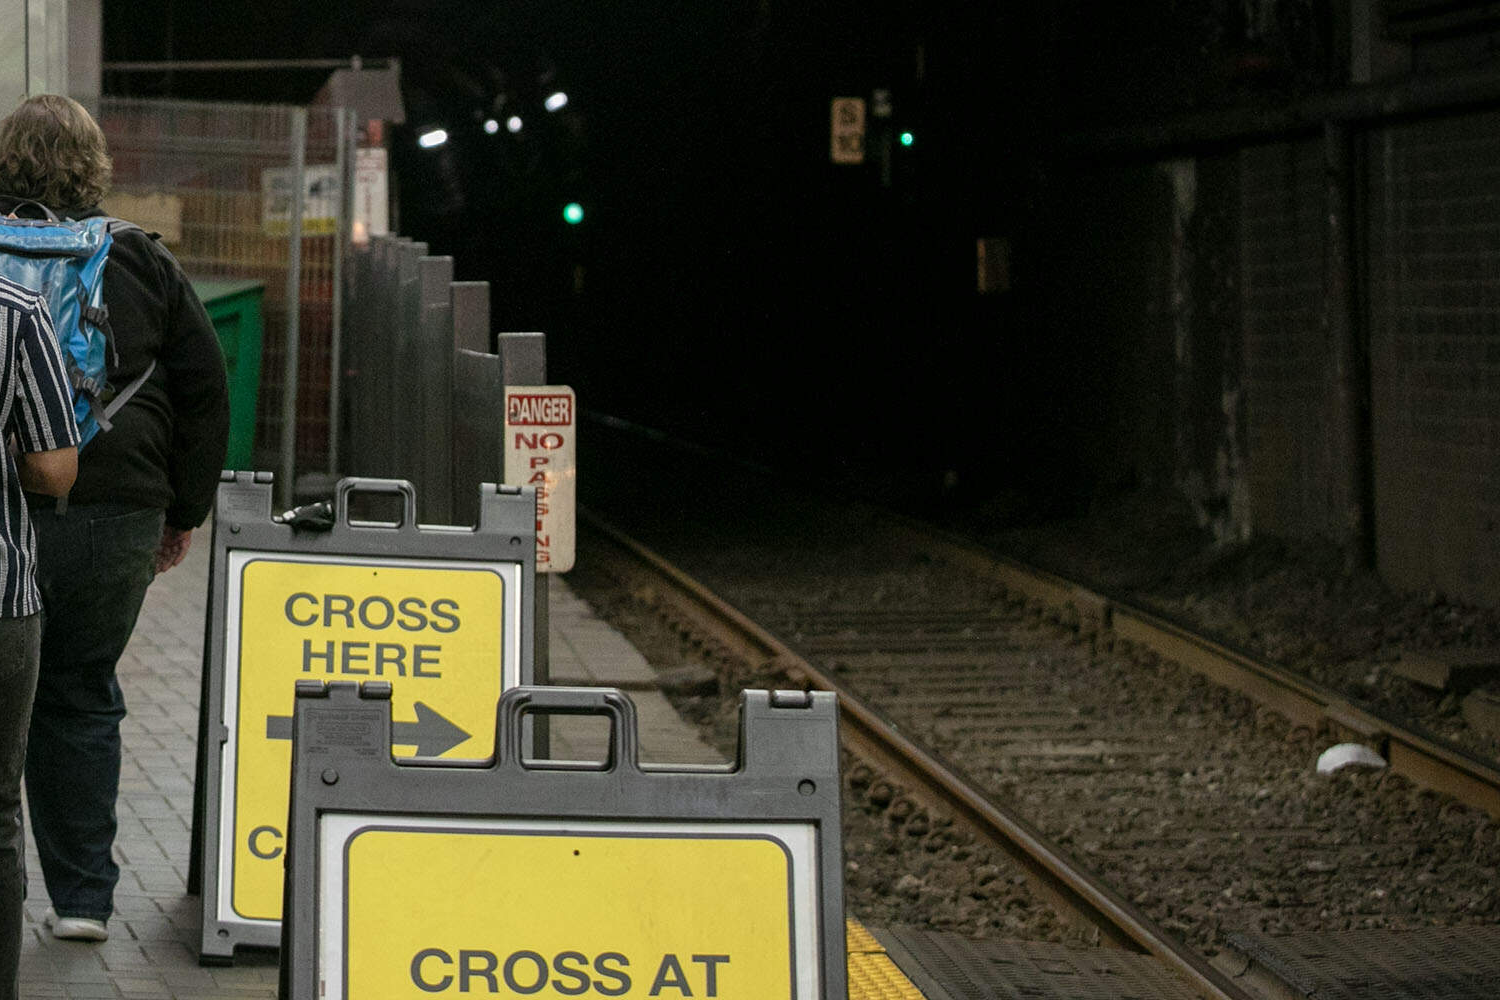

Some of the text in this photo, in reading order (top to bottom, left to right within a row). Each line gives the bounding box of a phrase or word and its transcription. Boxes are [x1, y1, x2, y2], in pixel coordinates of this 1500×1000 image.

[511, 398, 570, 422] DANGER
[515, 433, 564, 449] NO
[284, 591, 461, 634] CROSS
[302, 639, 443, 679] HERE
[410, 947, 731, 998] CROSS AT
